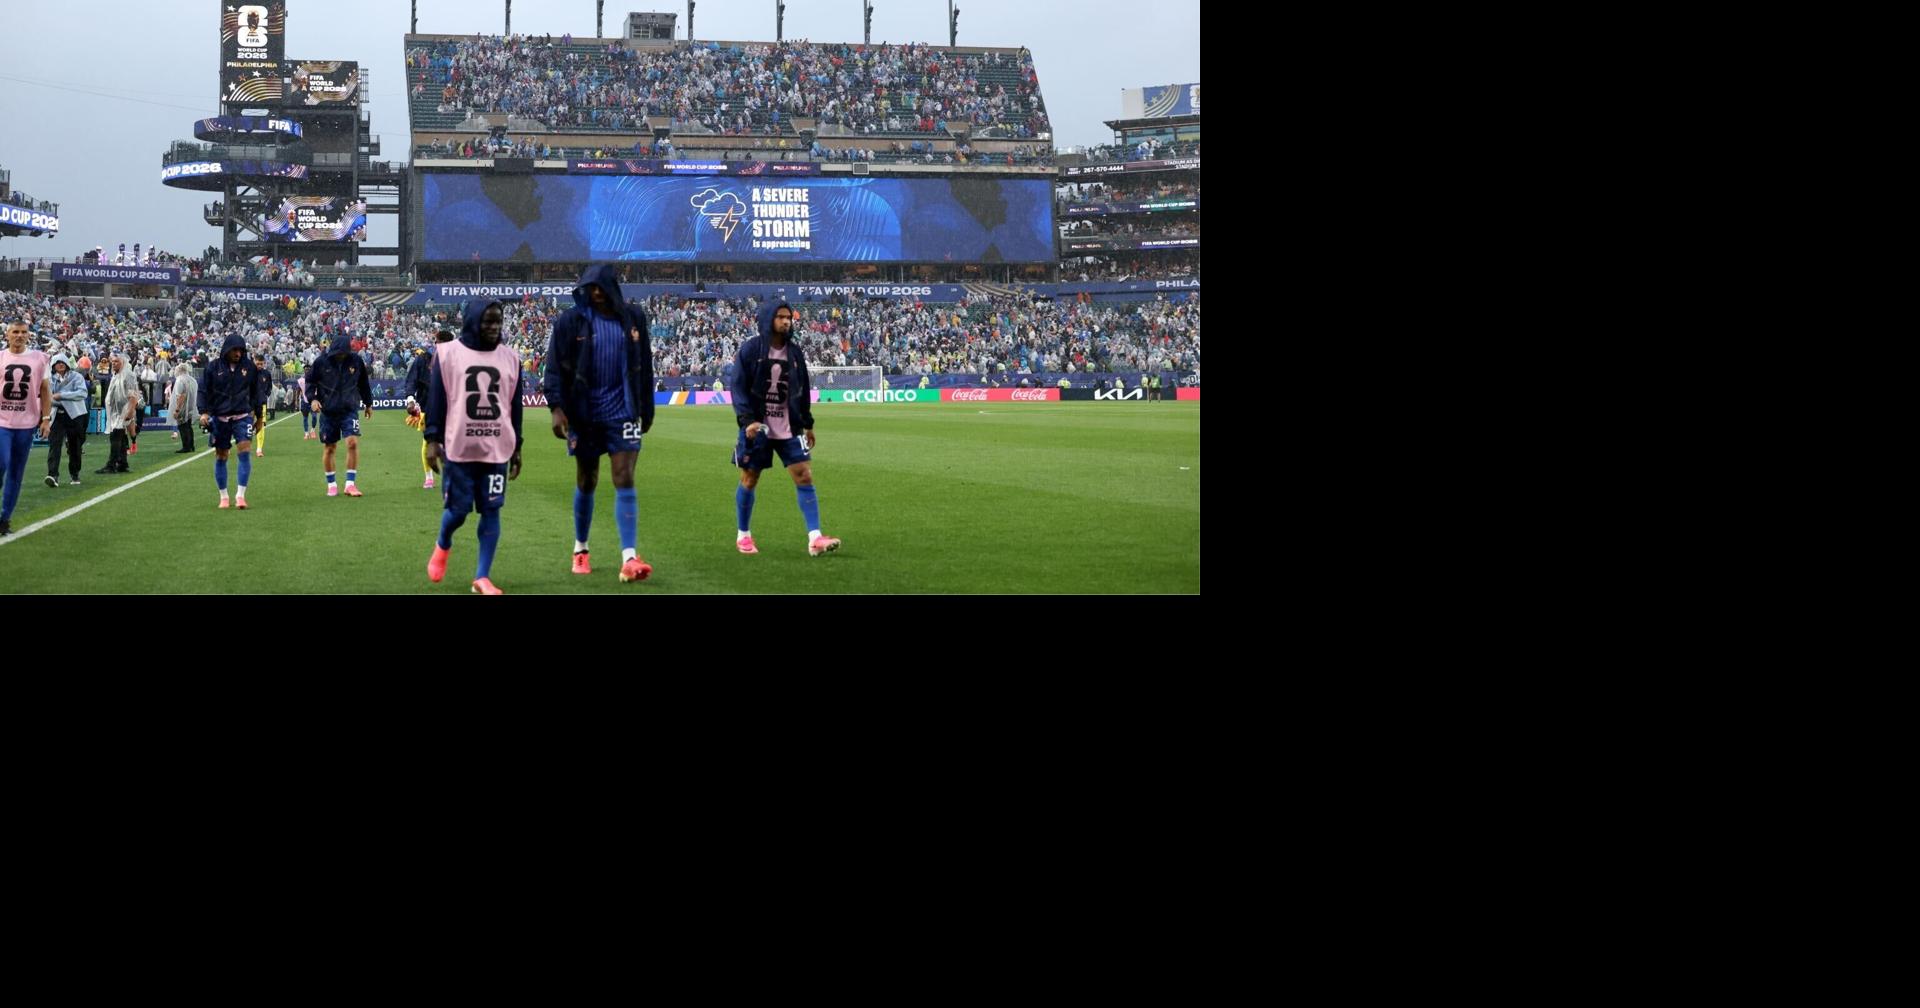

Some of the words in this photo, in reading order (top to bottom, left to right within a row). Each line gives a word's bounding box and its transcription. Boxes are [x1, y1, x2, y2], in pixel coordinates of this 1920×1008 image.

[268, 120, 291, 131] FIFA
[168, 165, 181, 176] CUP
[182, 162, 222, 174] 2026
[752, 189, 762, 201] A
[764, 189, 809, 202] SEVERE
[11, 209, 31, 225] CUP
[752, 204, 809, 218] THUNDER
[752, 220, 810, 237] STORM
[762, 239, 811, 249] approaching
[62, 268, 82, 276] FIFA
[84, 269, 118, 278] WORLD
[119, 270, 138, 278] CUP
[139, 271, 170, 280] 2026
[441, 287, 466, 296] FIFA
[469, 287, 513, 296] WORLD
[516, 287, 540, 295] CUP
[542, 287, 574, 296] 202
[867, 287, 890, 296] CUP
[892, 287, 932, 296] 2026
[843, 389, 917, 401] aramco
[951, 389, 988, 400] Coca-Cola
[1011, 389, 1048, 400] Coca-Cola
[465, 428, 501, 437] 2026
[623, 421, 641, 439] 22
[488, 474, 504, 494] 13
